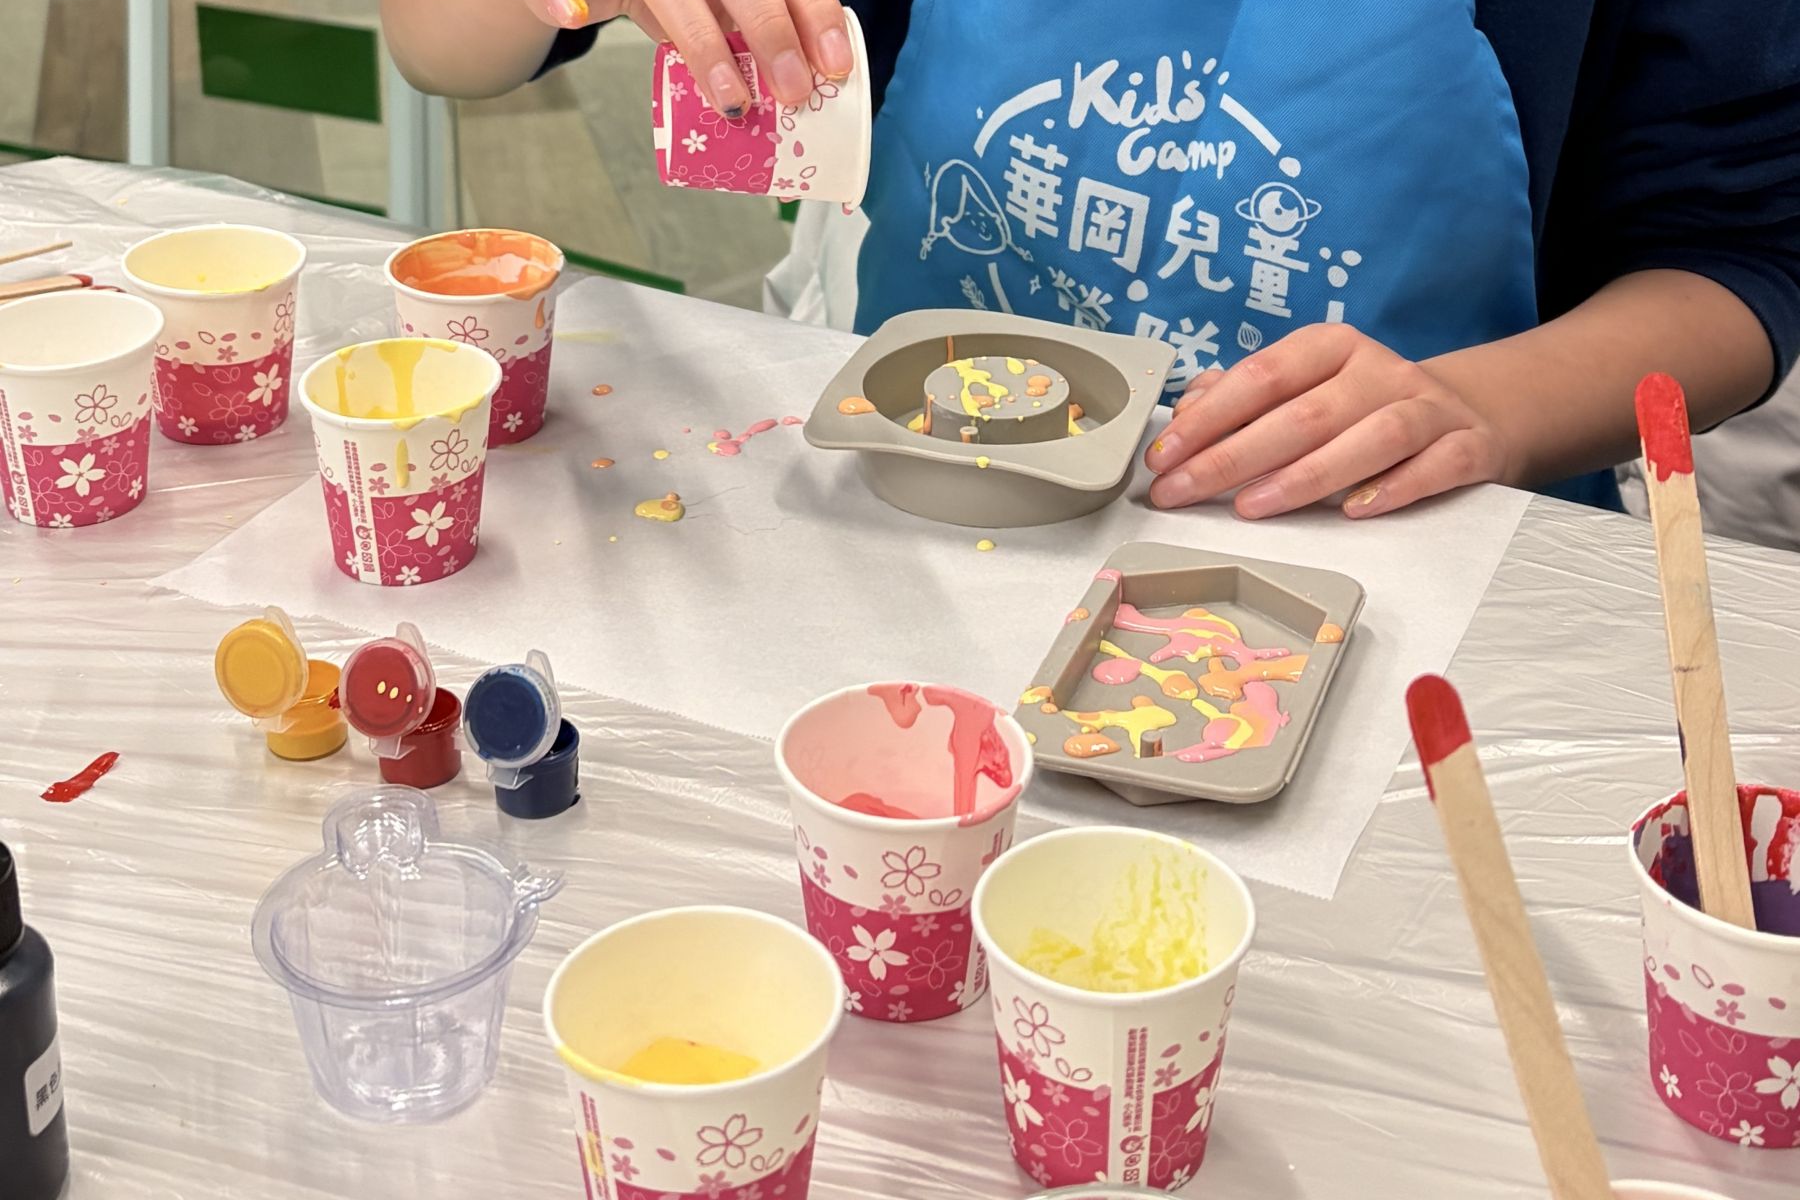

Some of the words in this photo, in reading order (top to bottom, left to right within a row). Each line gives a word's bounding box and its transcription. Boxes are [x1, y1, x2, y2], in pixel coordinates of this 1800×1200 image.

[1116, 128, 1237, 178] Camp
[1003, 133, 1310, 318] 華岡兒童
[36, 1061, 61, 1111] 黑色
